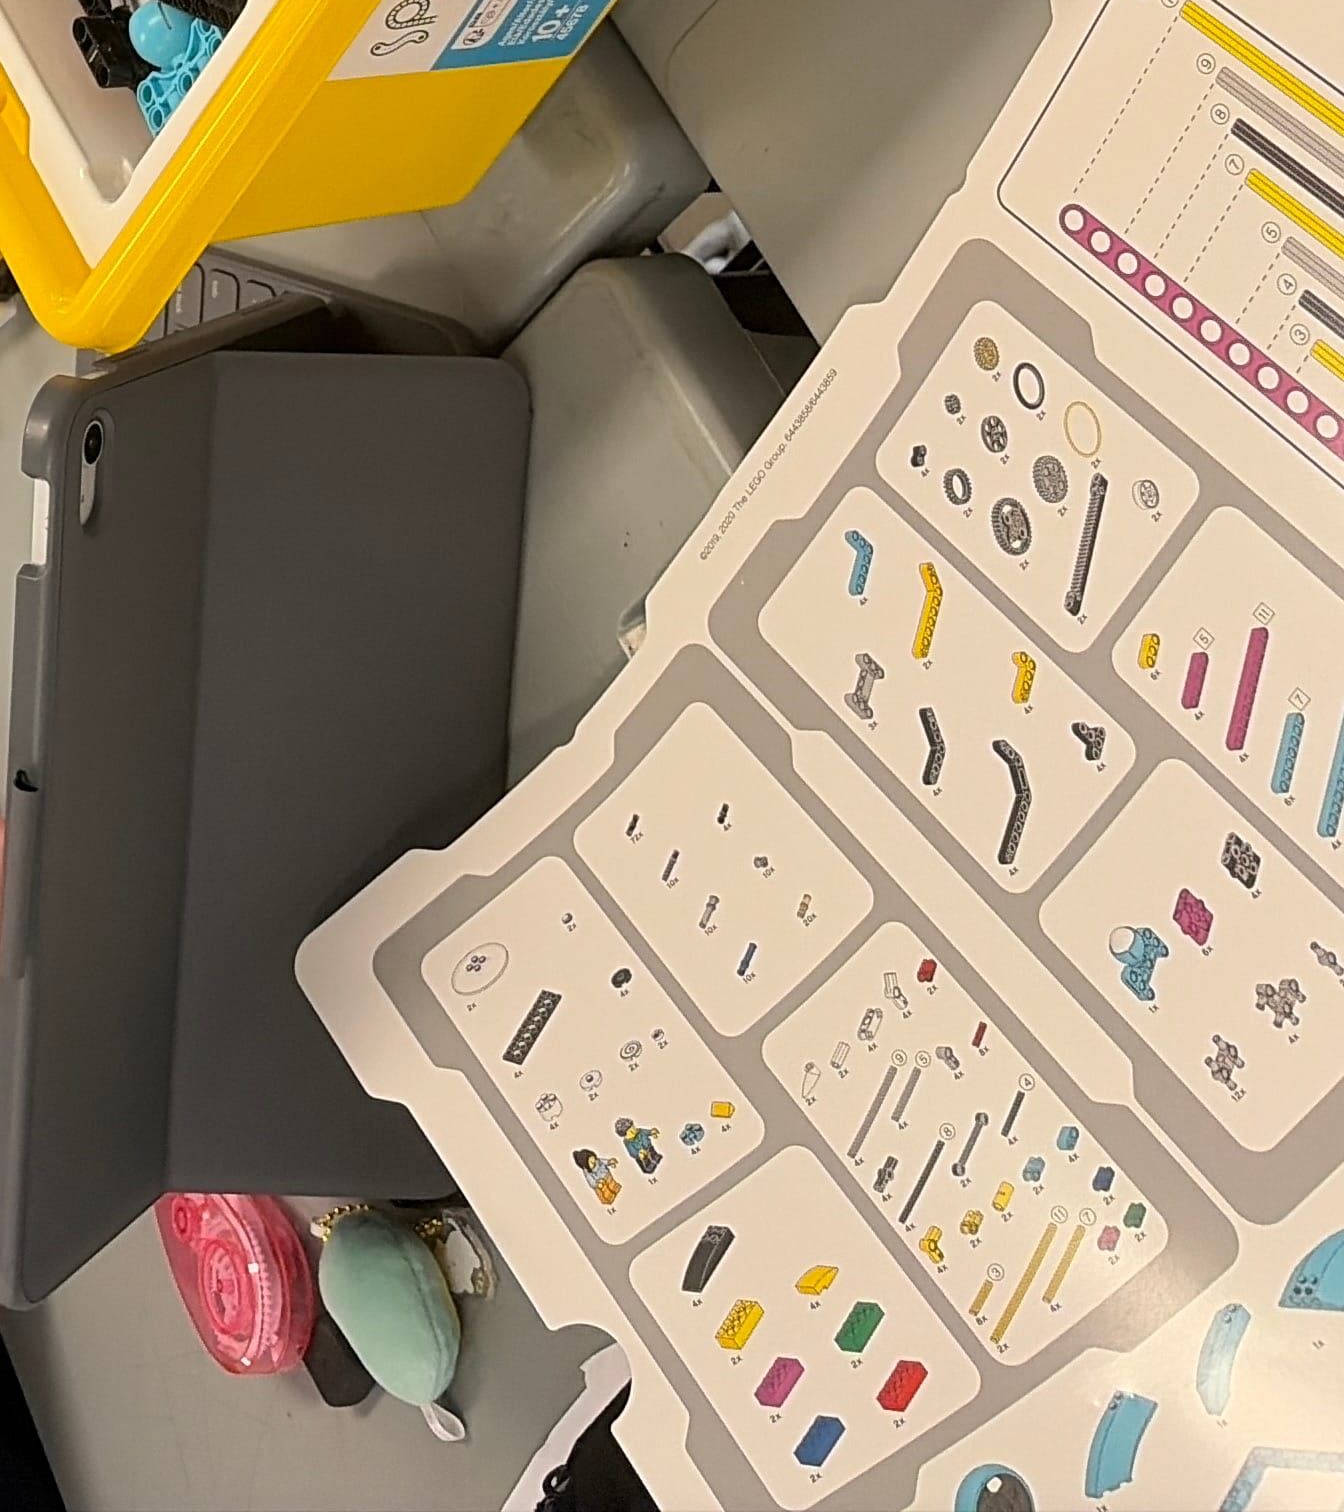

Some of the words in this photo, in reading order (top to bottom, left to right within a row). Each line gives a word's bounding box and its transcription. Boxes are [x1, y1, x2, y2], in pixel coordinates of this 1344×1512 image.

[555, 4, 589, 41] 45678
[719, 511, 736, 534] 2020
[733, 496, 748, 511] The
[745, 469, 766, 496] LEGO
[764, 443, 787, 469] Group.
[630, 832, 643, 844] 72x
